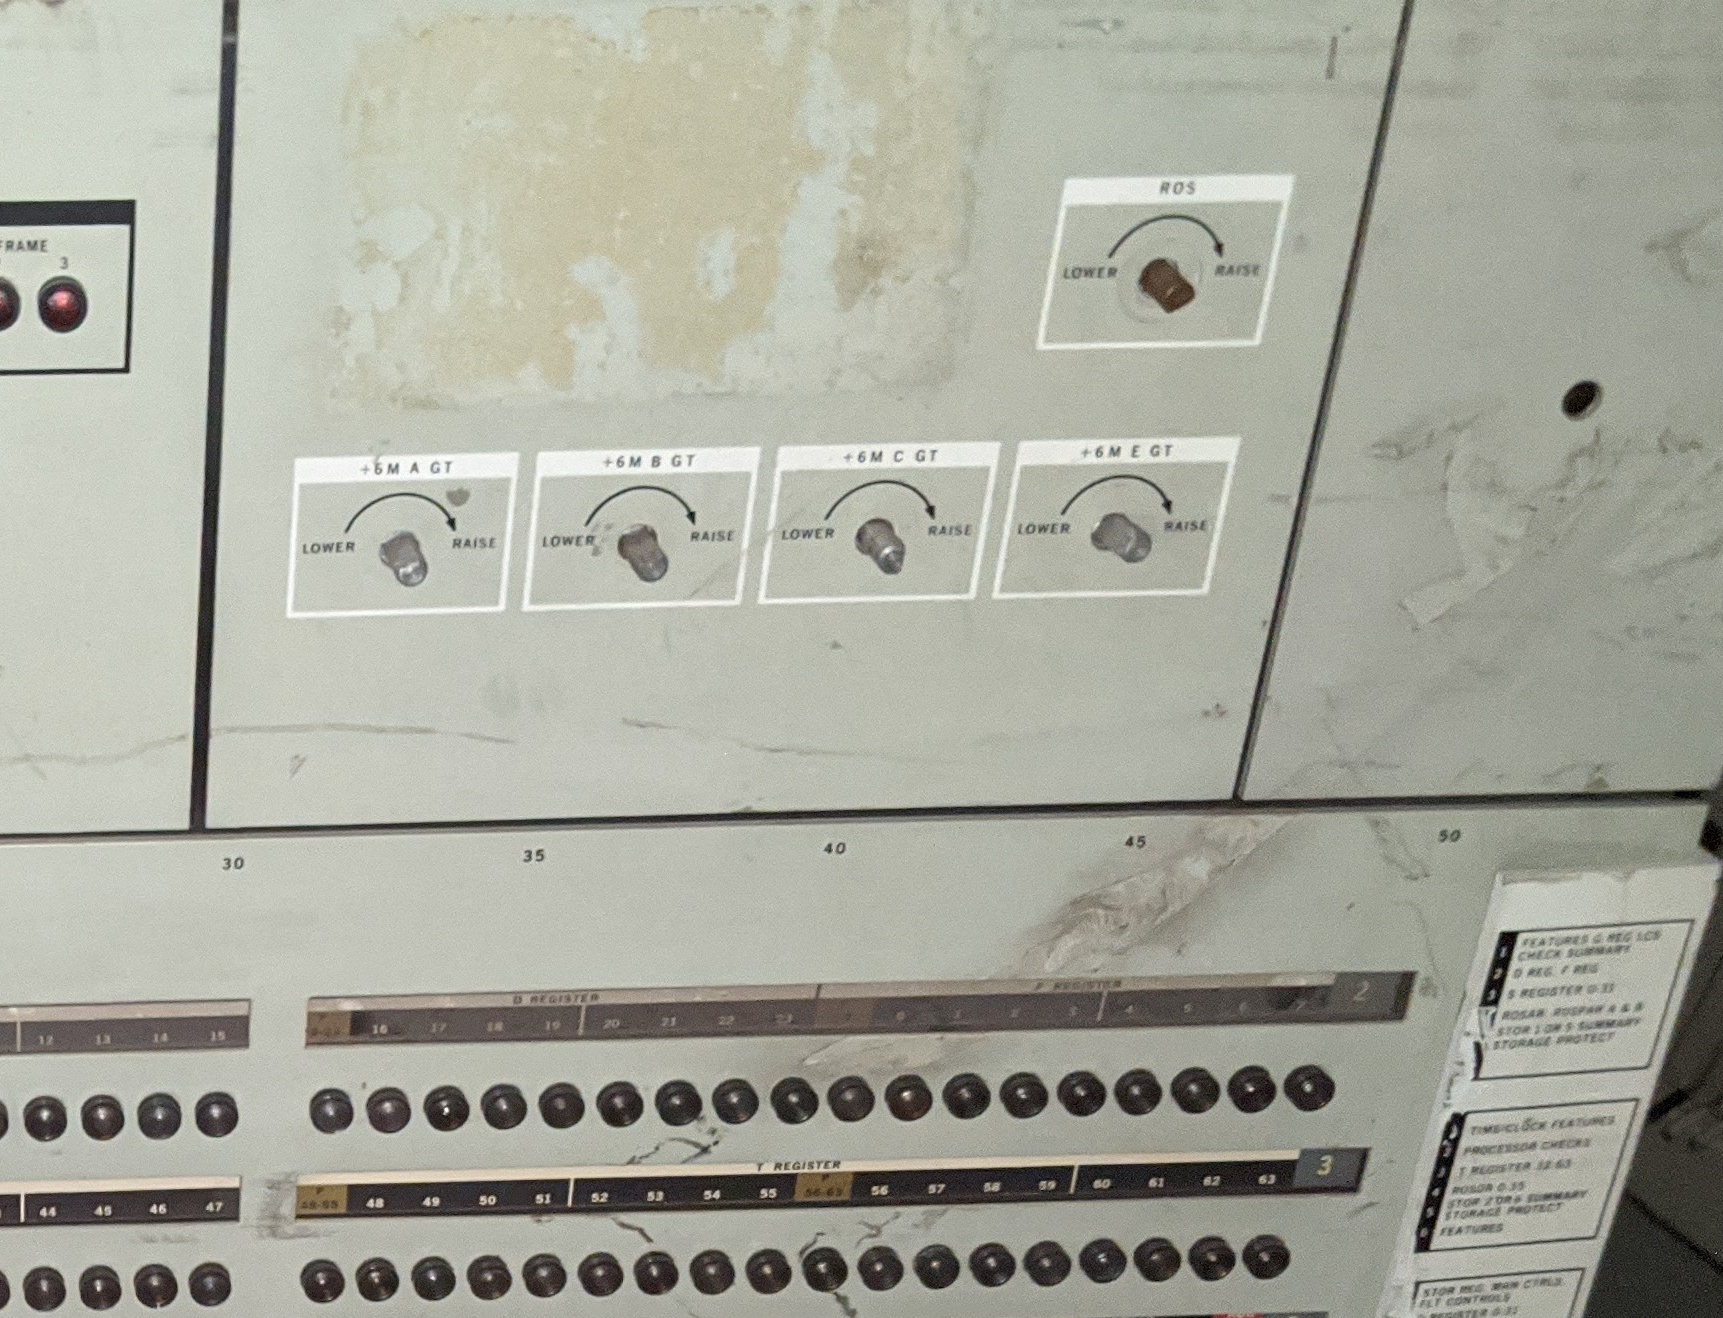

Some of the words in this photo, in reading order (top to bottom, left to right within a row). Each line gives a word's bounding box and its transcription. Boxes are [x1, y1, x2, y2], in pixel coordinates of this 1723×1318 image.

[1158, 181, 1197, 196] ROS
[59, 256, 69, 270] 3
[1214, 263, 1262, 278] RAISE
[1062, 265, 1118, 280] LOWER
[892, 449, 905, 464] C
[915, 448, 939, 464] GT
[1131, 444, 1142, 459] E
[1149, 444, 1174, 458] GT
[409, 461, 421, 476] A
[429, 460, 454, 476] GT
[651, 455, 662, 469] B
[670, 454, 698, 468] GT
[780, 527, 836, 542] LOWER
[926, 524, 973, 538] RAISE
[1016, 522, 1071, 537] LOWER
[1163, 520, 1209, 534] RAISE
[452, 536, 497, 550] RAISE
[541, 534, 597, 548] LOWER
[690, 530, 735, 544] RAISE
[301, 540, 356, 556] LOWER
[221, 856, 246, 872] 30
[522, 848, 546, 864] 35
[823, 841, 847, 856] 40
[1125, 834, 1147, 850] 45
[1438, 828, 1462, 844] 50
[529, 992, 600, 1005] REGISTER
[1352, 980, 1371, 1002] 2
[1519, 984, 1584, 1000] REGISTER
[773, 1160, 842, 1172] REGISTER
[1316, 1155, 1334, 1176] 3
[365, 1197, 384, 1210] 48
[422, 1196, 440, 1208] 49
[478, 1194, 497, 1207] 50
[534, 1193, 552, 1206] 51
[590, 1192, 610, 1204] 52
[702, 1188, 722, 1200] 54
[758, 1187, 778, 1200] 55
[870, 1184, 890, 1197] 56
[927, 1182, 946, 1195] 57
[1148, 1176, 1166, 1189] 61
[1257, 1174, 1277, 1186] 63
[38, 1206, 58, 1218] 44
[93, 1204, 113, 1217] 45
[148, 1203, 168, 1216] 46
[205, 1201, 224, 1214] 47
